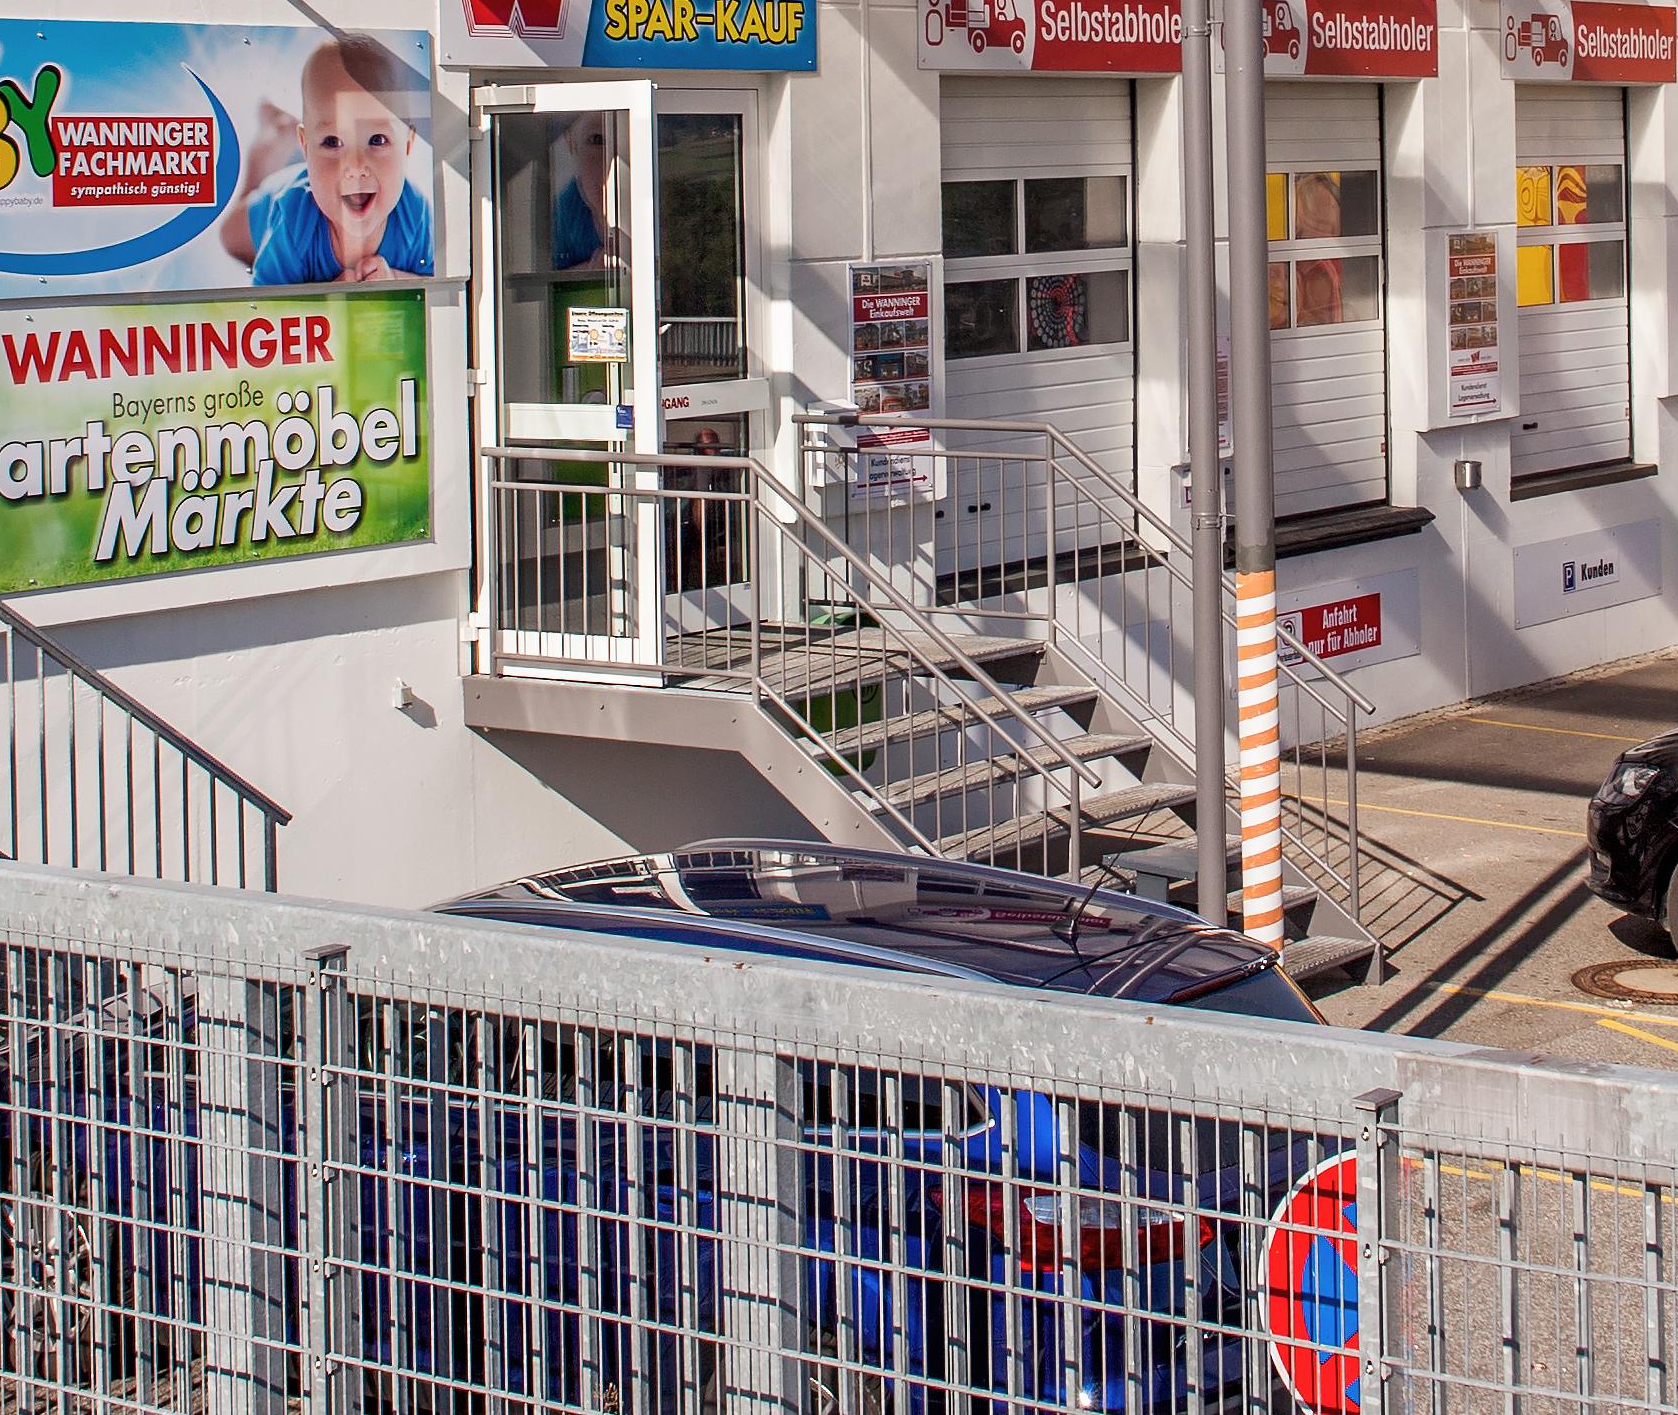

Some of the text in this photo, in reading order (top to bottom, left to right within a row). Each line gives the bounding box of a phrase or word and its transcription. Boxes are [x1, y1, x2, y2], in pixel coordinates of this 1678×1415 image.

[1041, 0, 1182, 44] Selbstabhole
[1312, 11, 1433, 52] Selbstabholer
[1577, 24, 1673, 60] Selbstabholer
[57, 122, 209, 147] WANNINGER
[58, 151, 209, 176] FACHMARKT
[71, 182, 200, 198] sympathisch günstig!
[862, 296, 921, 309] Die WANNINGER
[869, 306, 914, 319] Einkaufswelt
[1, 315, 335, 385] WANNINGER
[112, 384, 264, 424] Bayerns große
[93, 460, 364, 562] Märkte
[1580, 559, 1614, 581] Kunden
[1323, 604, 1358, 629] Anfahrt
[1308, 624, 1378, 655] nur für Abholer
